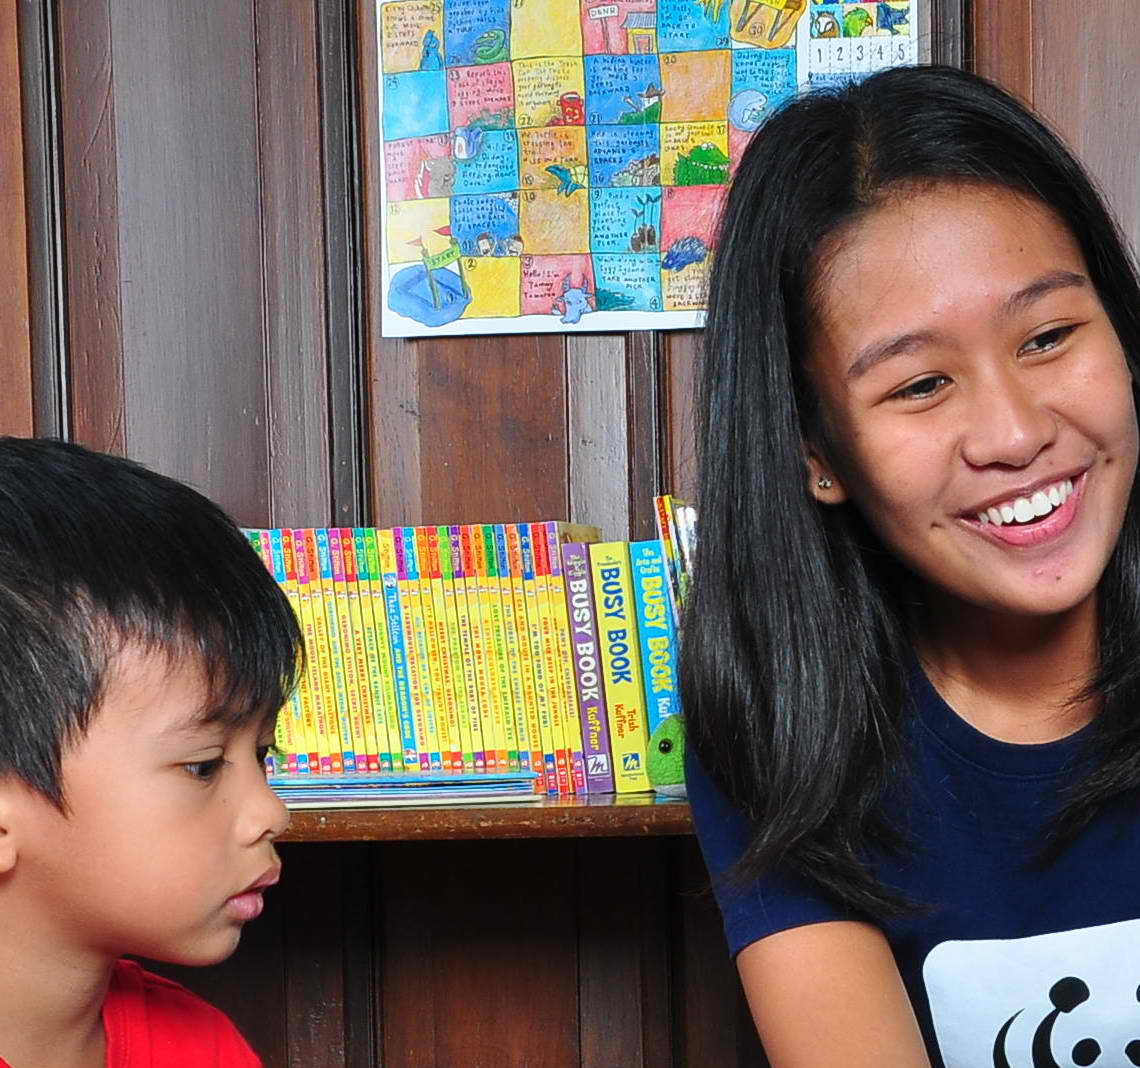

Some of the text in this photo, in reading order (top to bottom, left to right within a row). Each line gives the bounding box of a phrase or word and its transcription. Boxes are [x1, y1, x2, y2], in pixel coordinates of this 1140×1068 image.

[817, 43, 905, 63] 1 2 3 4 5
[568, 579, 592, 636] BUSY
[600, 567, 626, 621] BUSY
[641, 576, 665, 629] BUSY
[576, 641, 599, 702] BOOK
[607, 629, 633, 685] BOOK
[647, 637, 673, 694] BOOK
[627, 708, 639, 732] Trish
